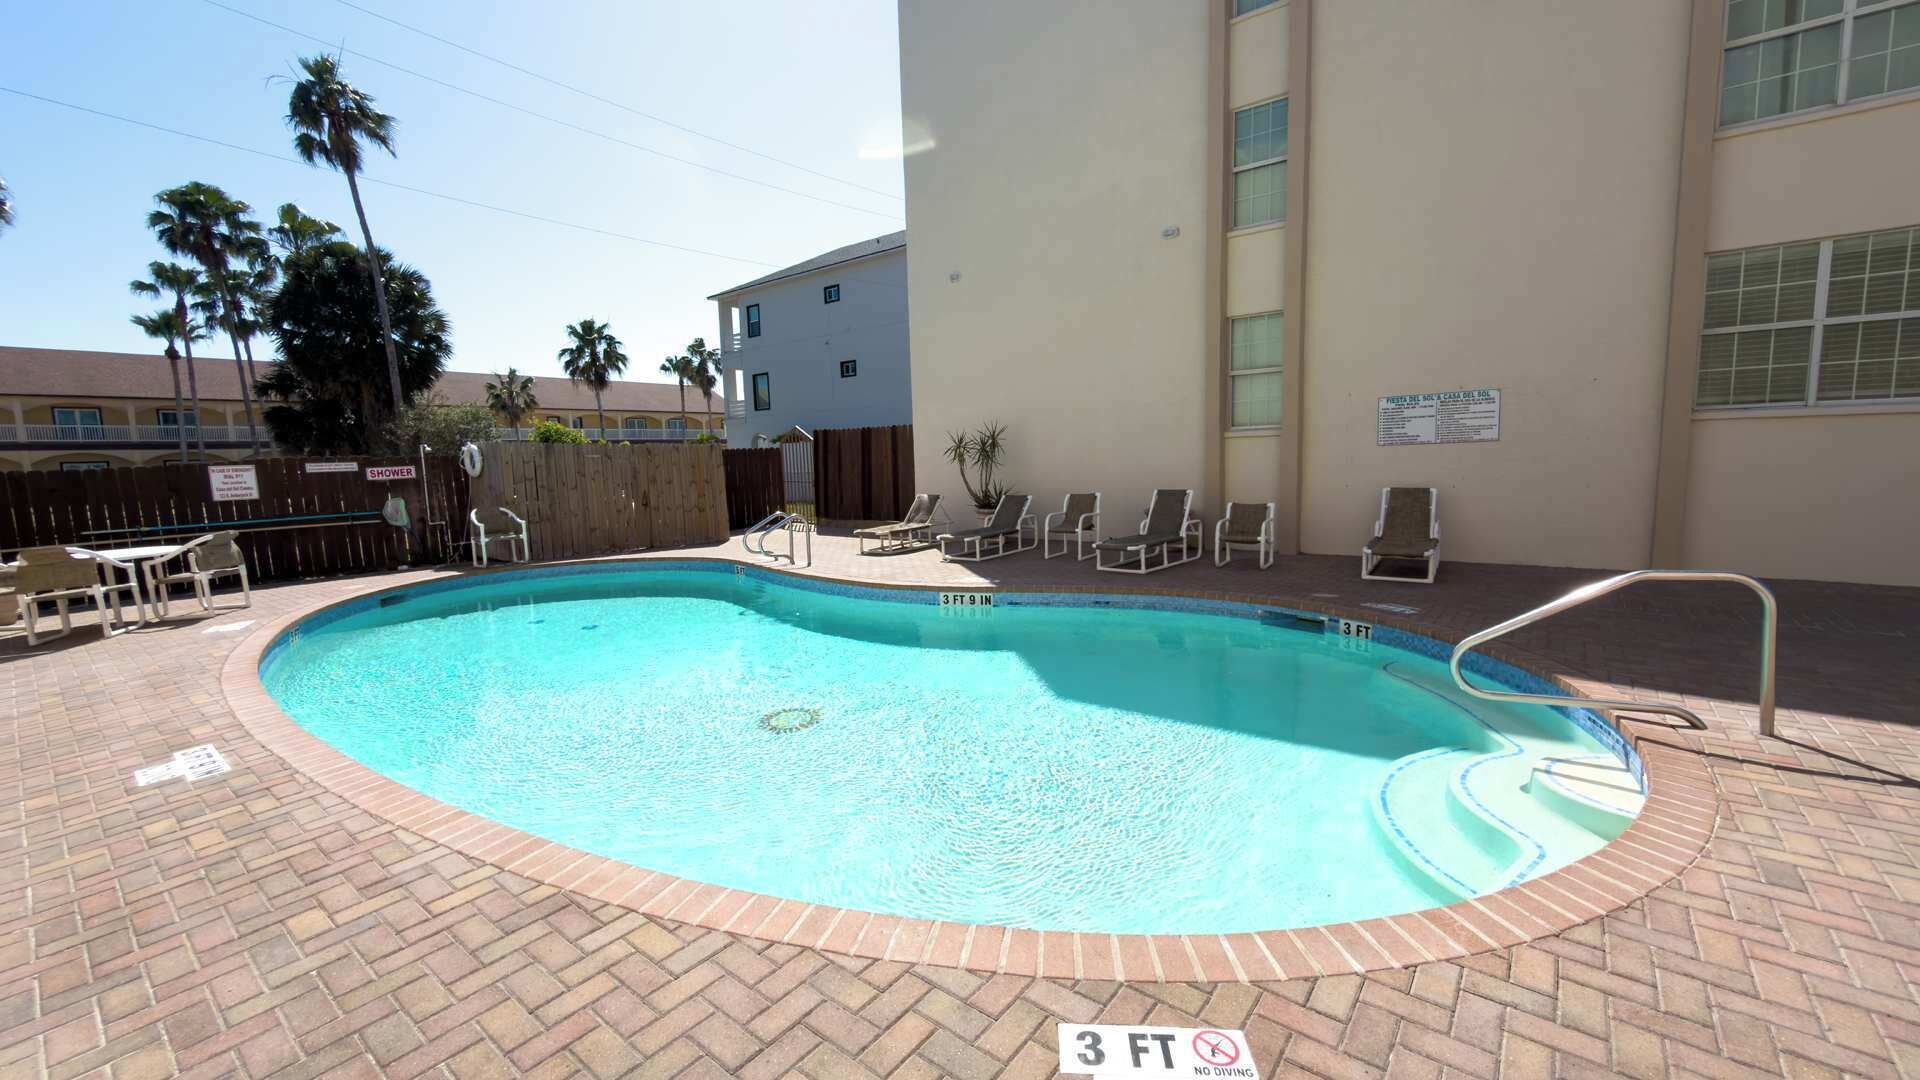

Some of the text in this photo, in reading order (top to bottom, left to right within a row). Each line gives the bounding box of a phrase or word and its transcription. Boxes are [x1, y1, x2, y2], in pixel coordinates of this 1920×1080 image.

[1386, 396, 1408, 404] FIESTA
[1444, 392, 1461, 400] CASA
[369, 468, 413, 478] SHOWER
[943, 594, 992, 605] 3 FT 9 IN
[1344, 622, 1371, 639] 3 FT
[1076, 1031, 1176, 1069] 3 FT
[1194, 1066, 1254, 1078] NO DIVING
